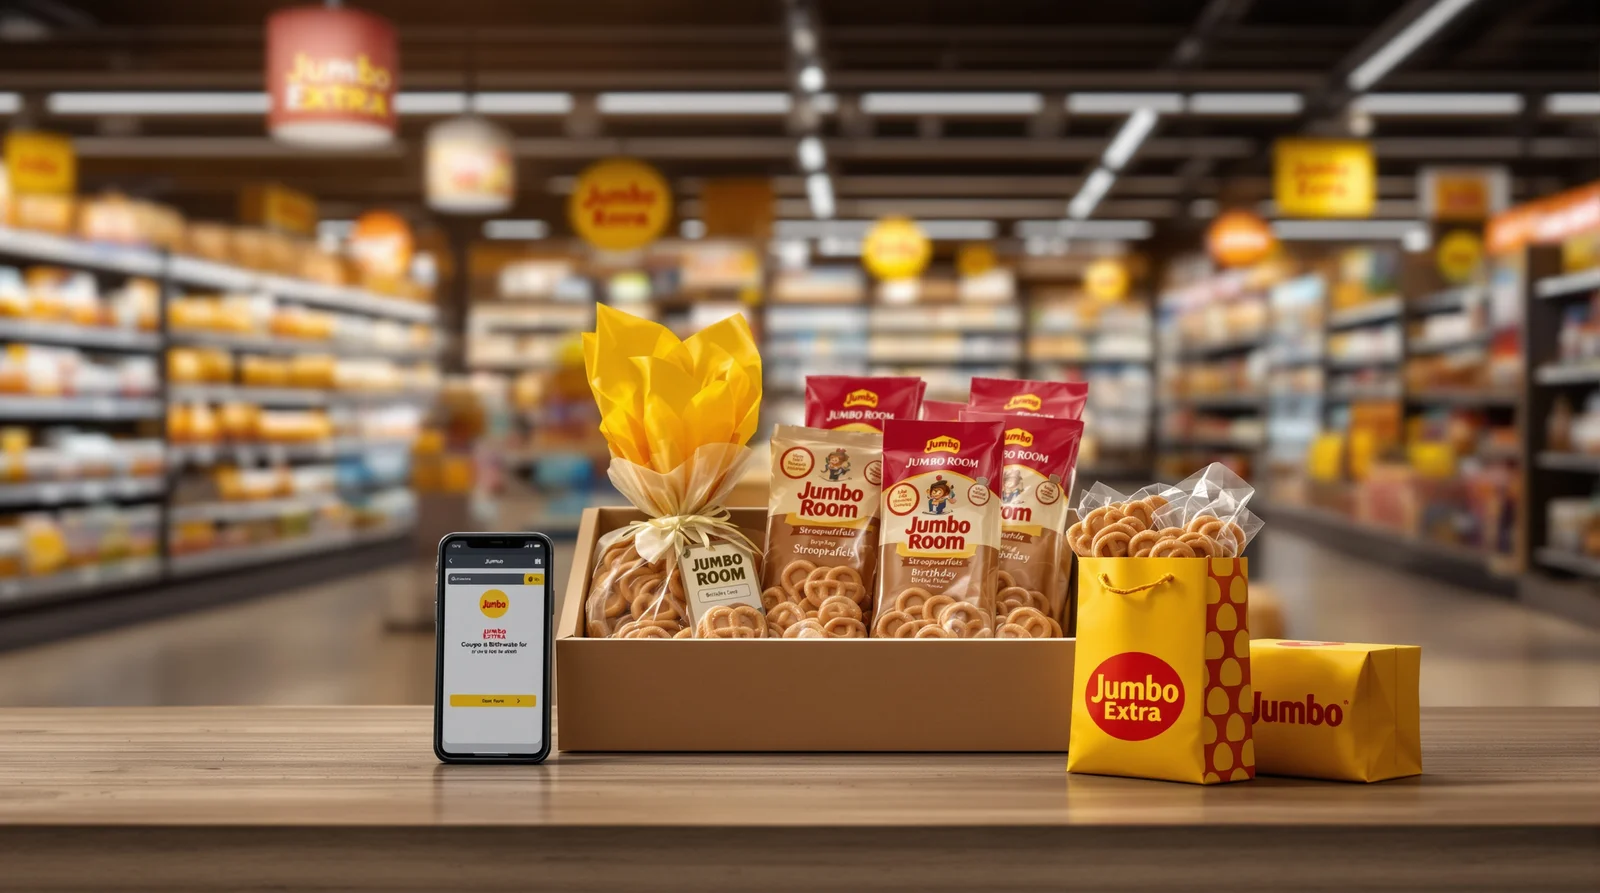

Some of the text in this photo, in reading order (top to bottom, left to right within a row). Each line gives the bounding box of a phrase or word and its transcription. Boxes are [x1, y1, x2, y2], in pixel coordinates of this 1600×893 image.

[285, 52, 390, 91] Jumbo
[285, 83, 388, 116] EXTRA
[826, 410, 894, 421] JUMBO ROOM
[905, 456, 979, 469] JUMBO ROOM
[1017, 450, 1049, 463] ROOM
[797, 481, 864, 502] Jumbo
[800, 499, 858, 518] Room
[905, 515, 971, 534] Jumbo
[908, 533, 965, 550] Room
[692, 553, 743, 572] JUMBO
[696, 567, 746, 586] ROOM
[482, 599, 506, 609] Jumbo
[1091, 673, 1179, 703] Jumbo
[1104, 701, 1162, 722] Extra
[1251, 691, 1344, 728] Jumbo
